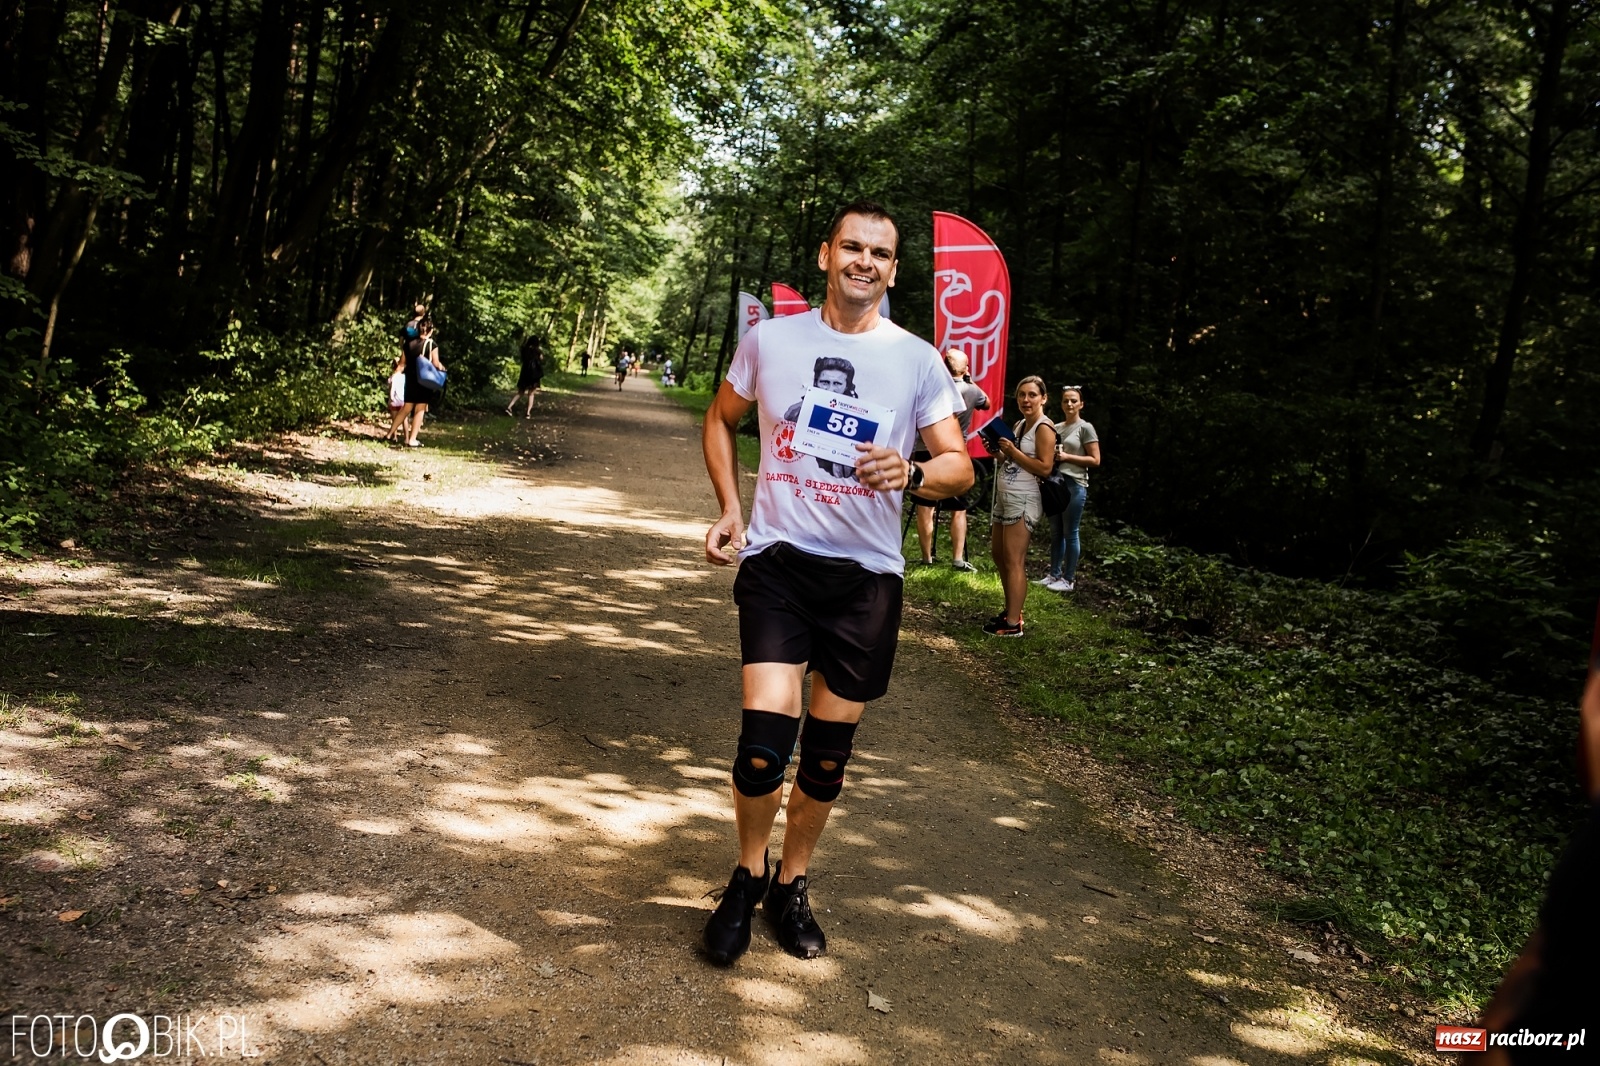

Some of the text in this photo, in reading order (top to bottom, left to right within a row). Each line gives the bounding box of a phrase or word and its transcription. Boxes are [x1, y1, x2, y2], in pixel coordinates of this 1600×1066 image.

[827, 412, 859, 437] 58
[766, 472, 876, 499] DANUTA SIEDZIKÓWNA
[795, 488, 840, 505] P. INKA
